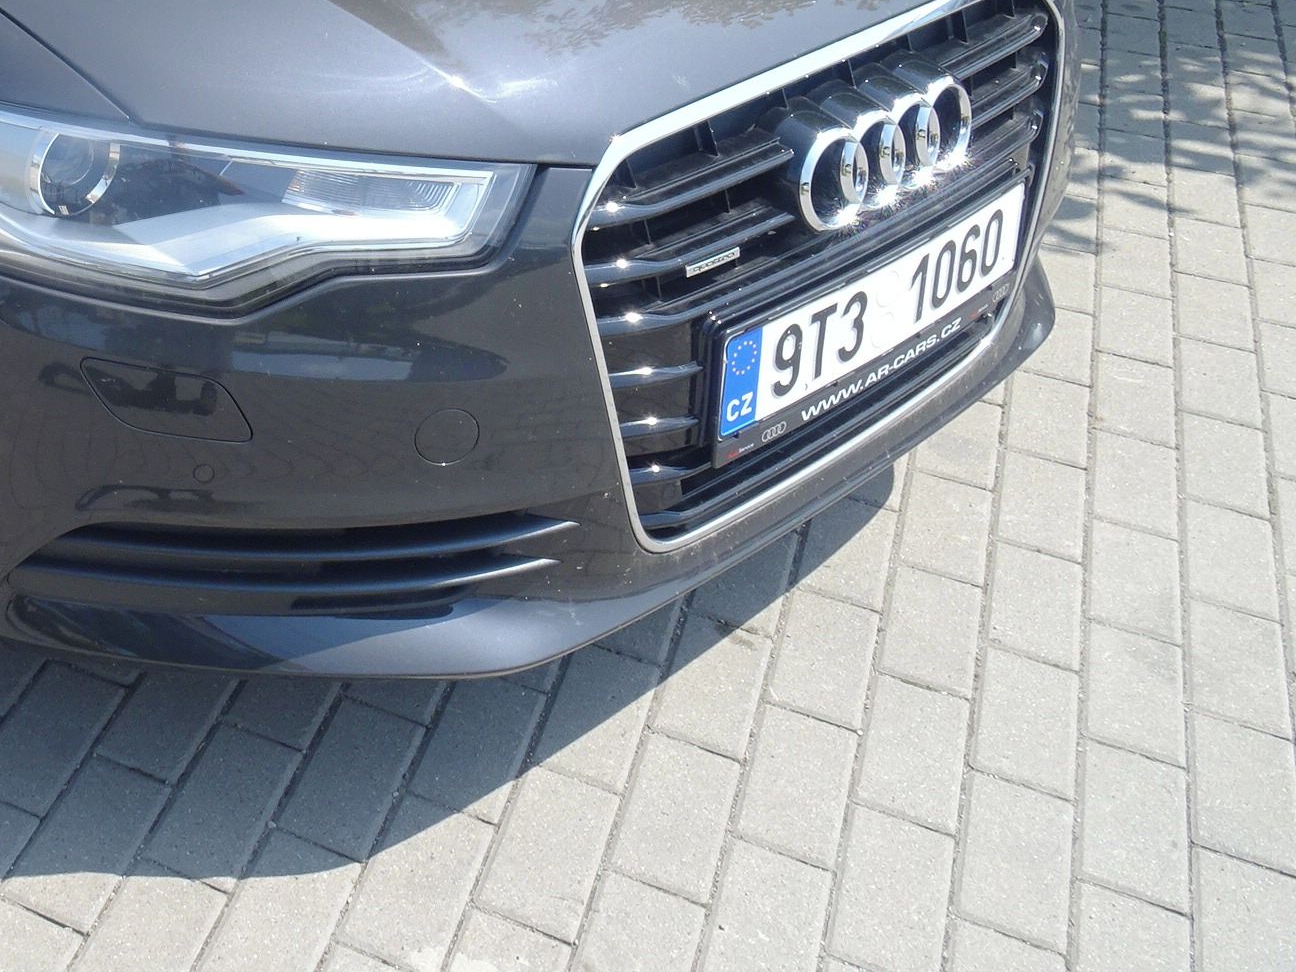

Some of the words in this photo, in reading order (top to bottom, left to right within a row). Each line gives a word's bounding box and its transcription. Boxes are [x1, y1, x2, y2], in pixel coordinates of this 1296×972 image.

[770, 290, 869, 398] 9T3
[909, 208, 1004, 325] 1060
[726, 391, 754, 423] CZ
